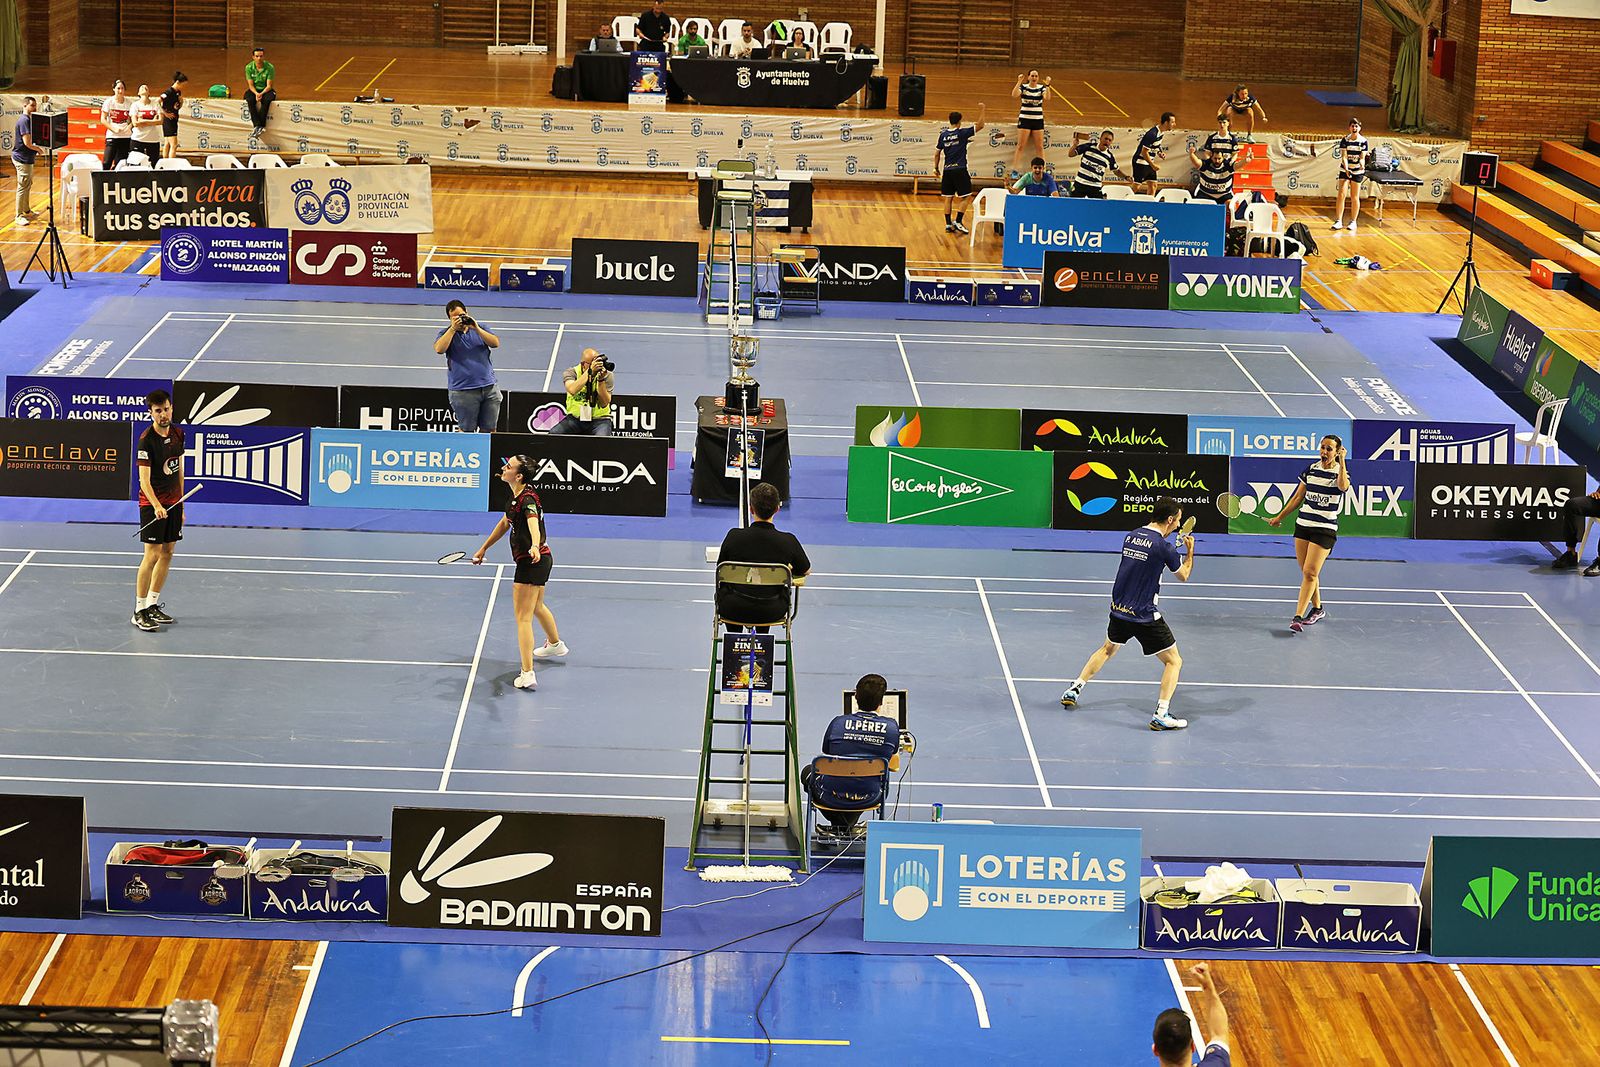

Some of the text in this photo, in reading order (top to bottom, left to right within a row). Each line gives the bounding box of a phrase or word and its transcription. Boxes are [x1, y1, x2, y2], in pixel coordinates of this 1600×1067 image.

[756, 69, 810, 79] Ayuntamiento
[771, 77, 810, 86] de Huelva
[1479, 163, 1491, 179] 0
[103, 178, 254, 204] Huelva eleva
[357, 192, 410, 201] DIPUTACIÓN
[358, 202, 409, 210] PROVINCIAL
[104, 206, 257, 231] tus sentidos.
[1018, 223, 1103, 248] Huelva
[1161, 239, 1200, 247] Ayuntamiento
[211, 239, 283, 249] HOTEL MARTÍN
[1161, 247, 1208, 257] HUELVA
[207, 251, 286, 261] ALONSO PINZÓN
[372, 257, 399, 266] Consejo
[372, 264, 401, 272] Superior
[595, 254, 675, 281] bucle
[797, 261, 898, 281] VANDA
[430, 273, 485, 289] Andalucía
[1080, 269, 1159, 283] enclave
[1222, 274, 1294, 298] YONEX
[915, 287, 969, 303] Andalucía
[1502, 324, 1531, 363] Huelva
[72, 395, 147, 406] HOTEL MAR
[67, 410, 152, 422] ALONSO PINZ
[611, 403, 657, 430] iHu
[621, 430, 653, 438] TELEFONÍA
[1088, 425, 1169, 447] Andalucía
[7, 443, 117, 461] enclave
[370, 448, 481, 469] LOTERÍAS
[383, 474, 468, 484] CON EL DEPORTE
[532, 458, 657, 485] ANDA
[1124, 468, 1210, 491] Andalucía
[892, 475, 983, 498] El Corte Inglés
[1123, 494, 1154, 504] Región
[1196, 496, 1210, 504] del
[1431, 485, 1571, 508] OKEYMAS
[1123, 504, 1154, 513] DEPO
[1431, 509, 1557, 520] FITNESS CLU
[1132, 537, 1153, 549] ABIÁN
[0, 858, 45, 887] ntal
[959, 851, 1126, 883] LOTERÍAS
[576, 882, 652, 899] ESPAÑA
[1528, 871, 1600, 896] Funda
[0, 890, 18, 906] do
[262, 886, 381, 914] Andalucía
[978, 892, 1106, 906] CON EL DEPORTE
[440, 898, 651, 931] BADMINTON
[1528, 897, 1600, 922] Unica
[1155, 915, 1270, 944] Andalucía
[1294, 918, 1410, 947] Andalucía
